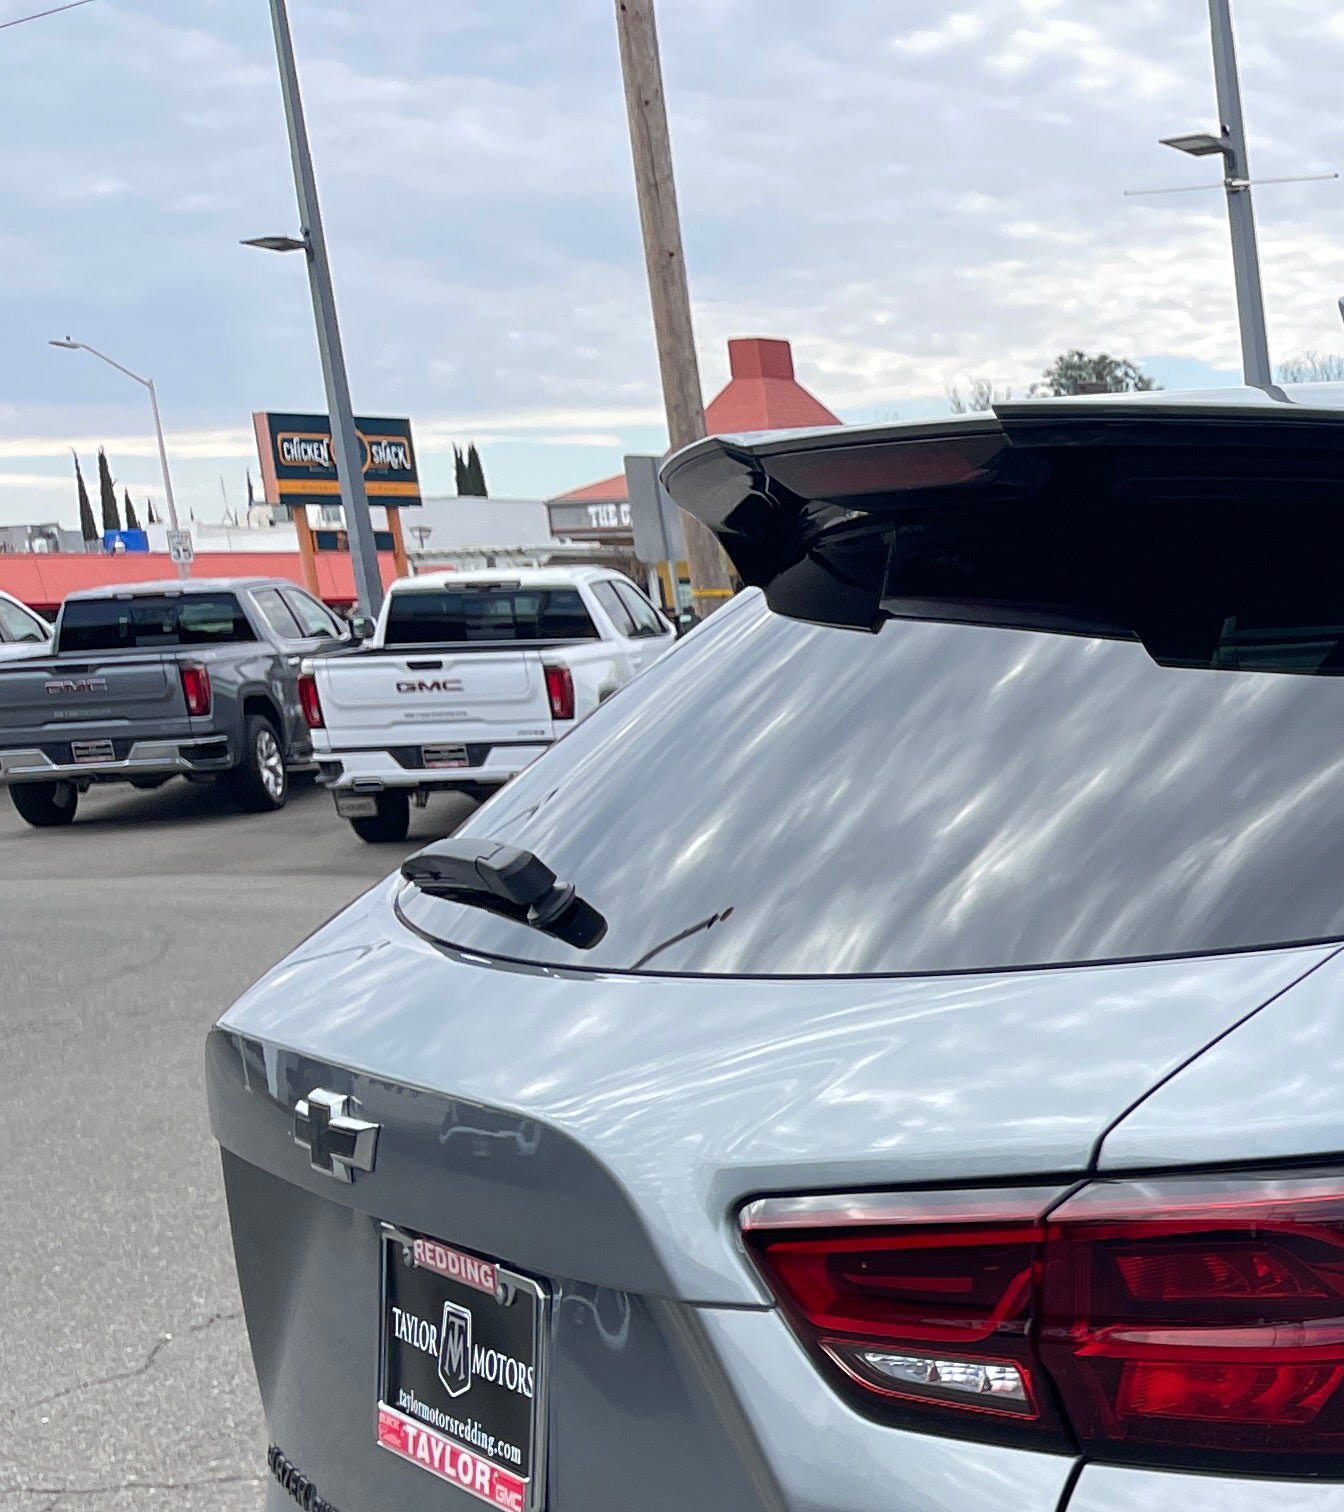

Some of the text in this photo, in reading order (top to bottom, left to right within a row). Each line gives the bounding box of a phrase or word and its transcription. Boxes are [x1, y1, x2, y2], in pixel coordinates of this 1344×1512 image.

[588, 503, 618, 528] THE
[45, 678, 107, 694] GMC
[396, 679, 464, 692] GMC
[414, 1239, 494, 1289] REDDING
[392, 1307, 534, 1398] TAYLOR MOTORS
[398, 1387, 522, 1465] taylormotorsredding.com
[402, 1422, 491, 1496] TAYLOR
[495, 1483, 522, 1511] GMC
